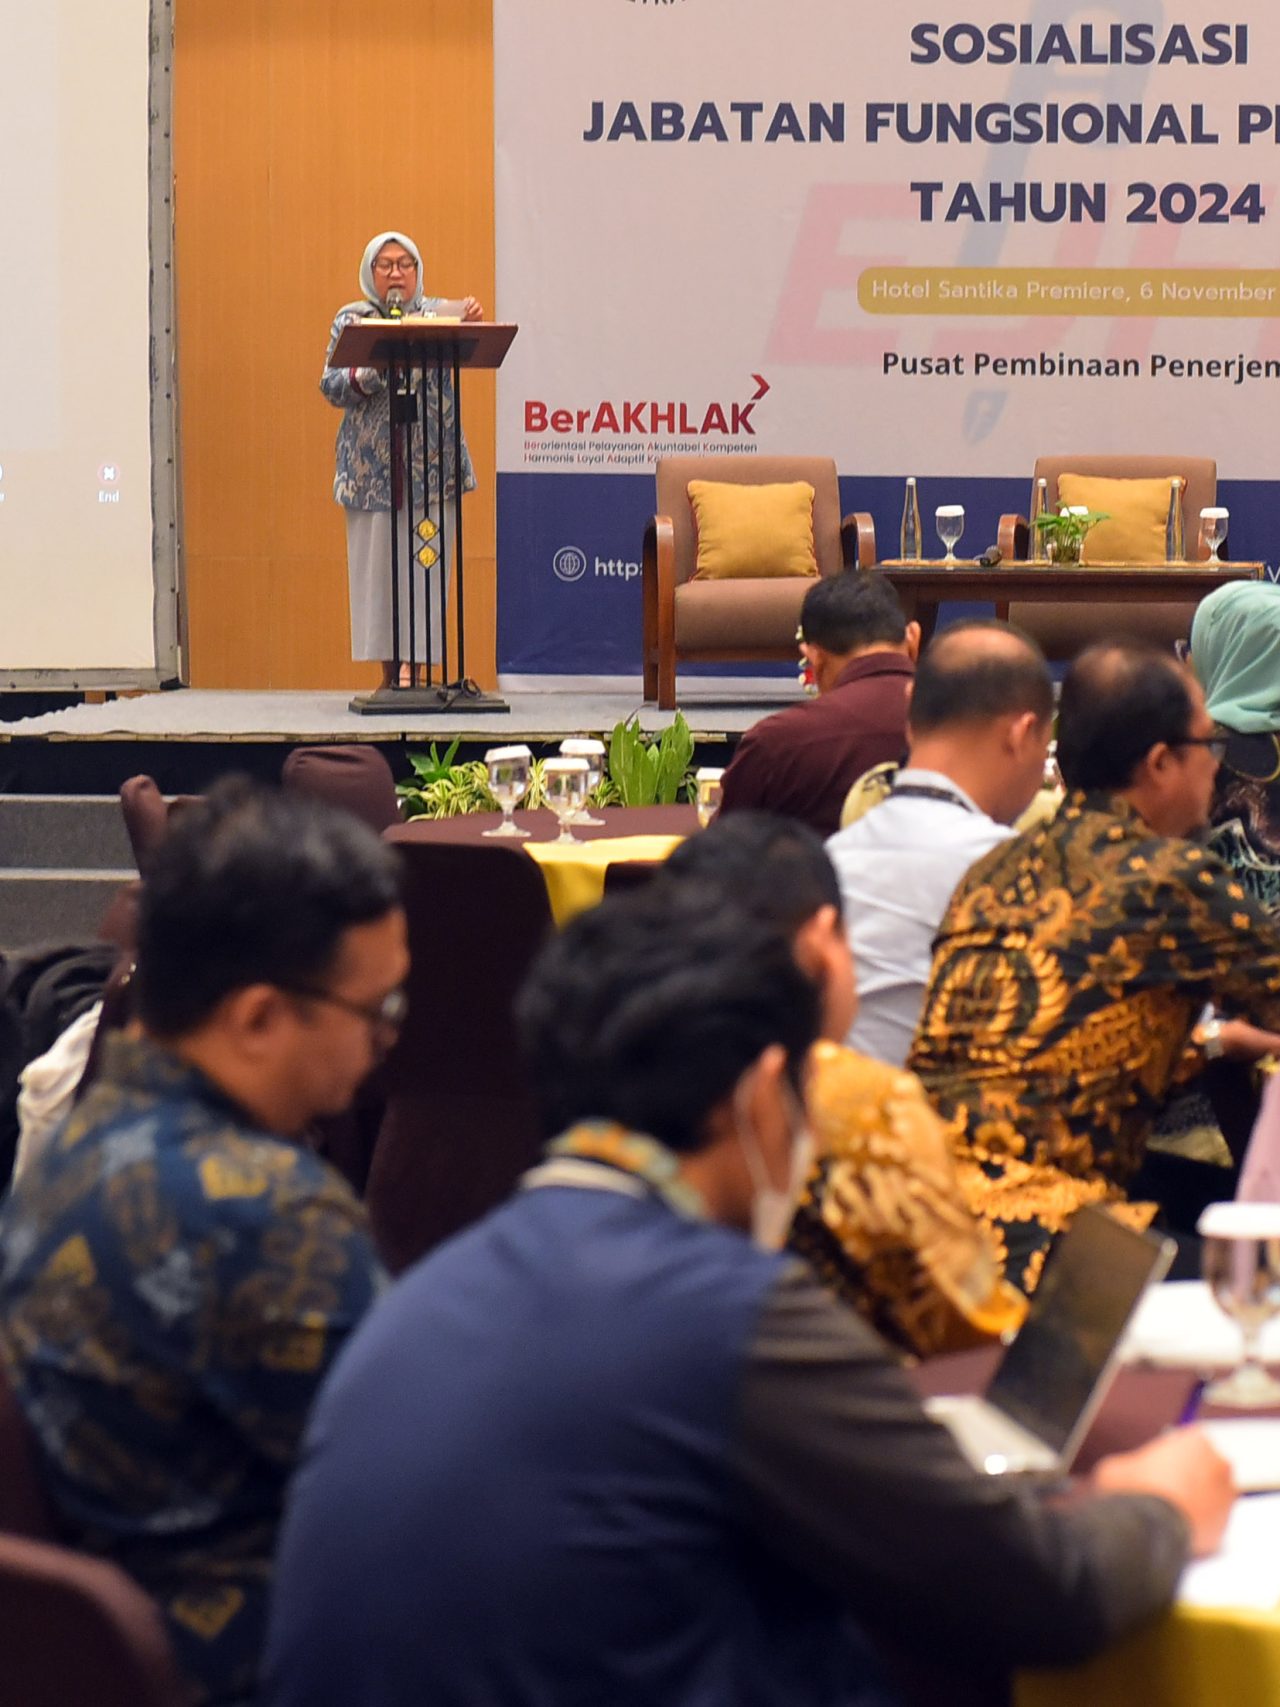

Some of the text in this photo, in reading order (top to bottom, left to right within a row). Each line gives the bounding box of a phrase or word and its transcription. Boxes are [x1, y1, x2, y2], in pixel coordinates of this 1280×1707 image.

[910, 22, 1248, 66] SOSIALISASI
[582, 101, 845, 143] JABATAN
[865, 102, 1219, 145] FUNGSIONAL
[910, 181, 1266, 224] TAHUN 2024
[872, 279, 930, 298] Hotel
[938, 280, 1018, 299] Santika
[1026, 281, 1131, 303] Premiere,
[1140, 281, 1153, 300] 6
[1162, 281, 1277, 301] November
[883, 352, 965, 376] Pusat
[974, 352, 1140, 377] Pembinaan
[524, 400, 756, 435] BerAKHLAK
[523, 441, 758, 454] Berorientasi Pelayanan Akuntabel Kompeten
[523, 454, 575, 463] Harmonis
[577, 454, 604, 465] Loyal
[606, 454, 645, 465] Adaptif
[98, 490, 120, 502] End
